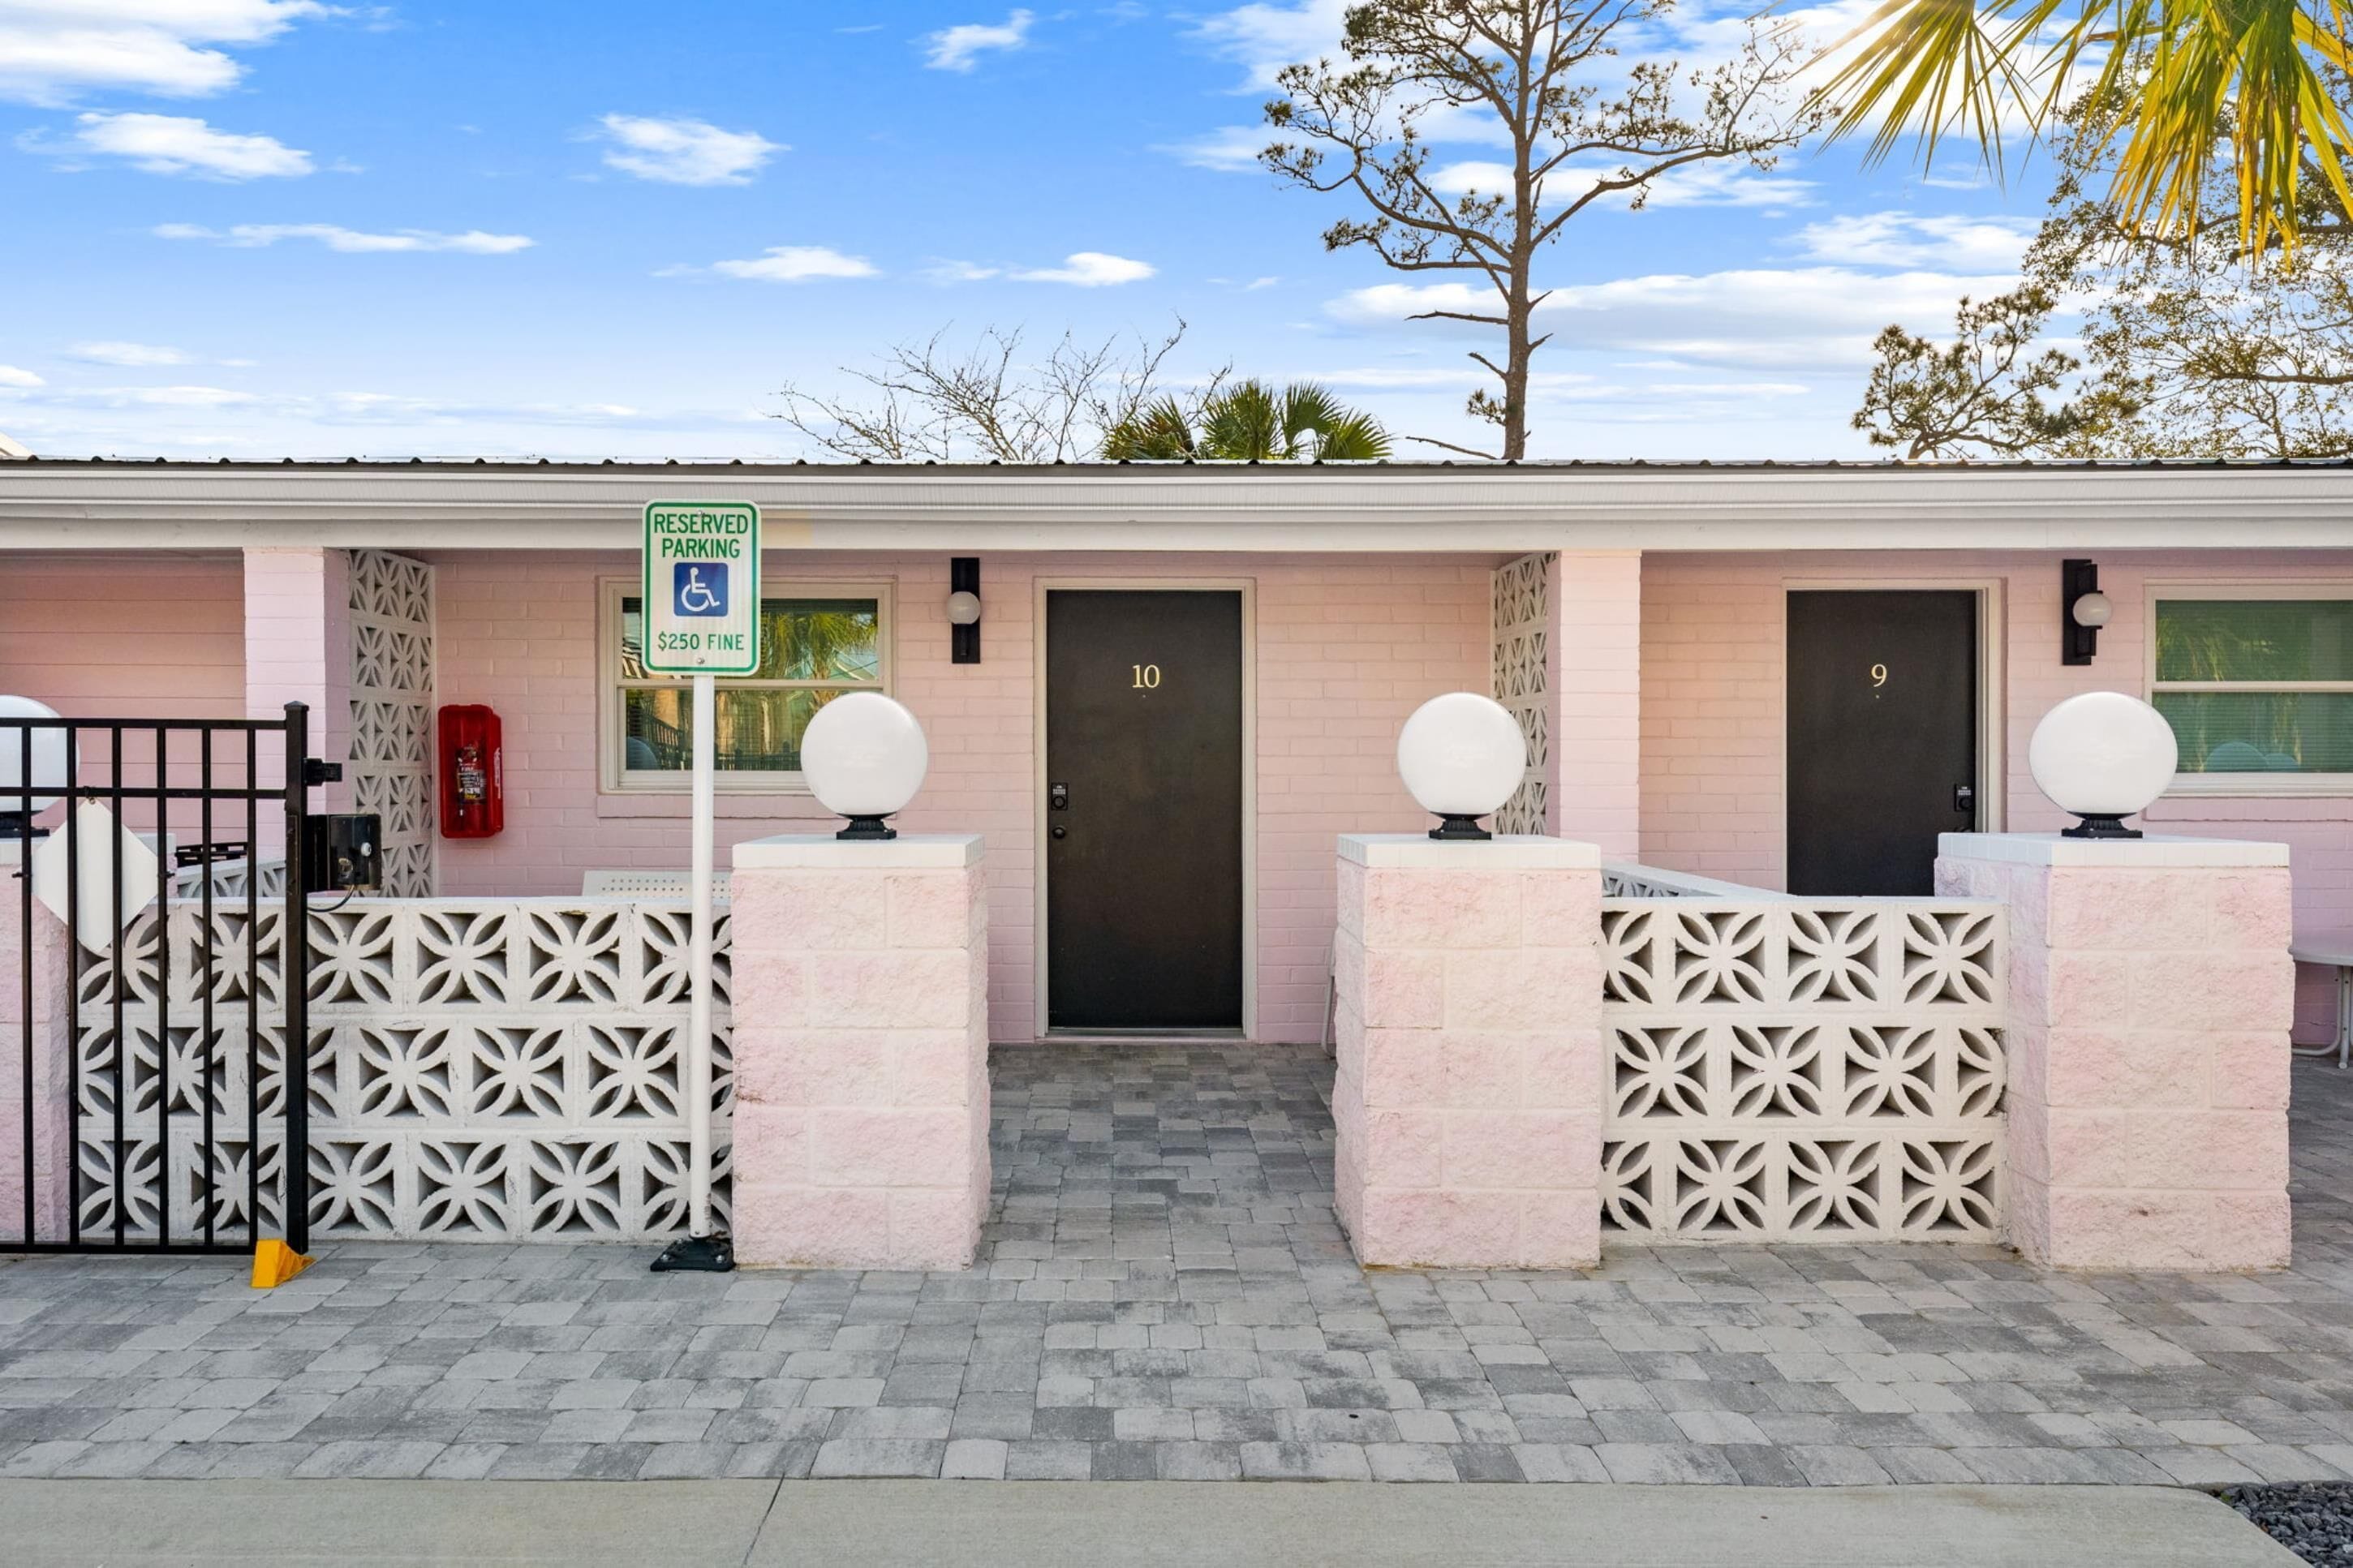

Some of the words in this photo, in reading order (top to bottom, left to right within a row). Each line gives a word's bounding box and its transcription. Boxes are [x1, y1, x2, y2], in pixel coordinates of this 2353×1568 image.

[653, 513, 749, 535] RESERVED
[661, 538, 741, 558] PARKING
[658, 631, 699, 651] $250
[708, 634, 745, 651] FINE
[1132, 664, 1160, 688] 10
[1871, 664, 1887, 687] 9
